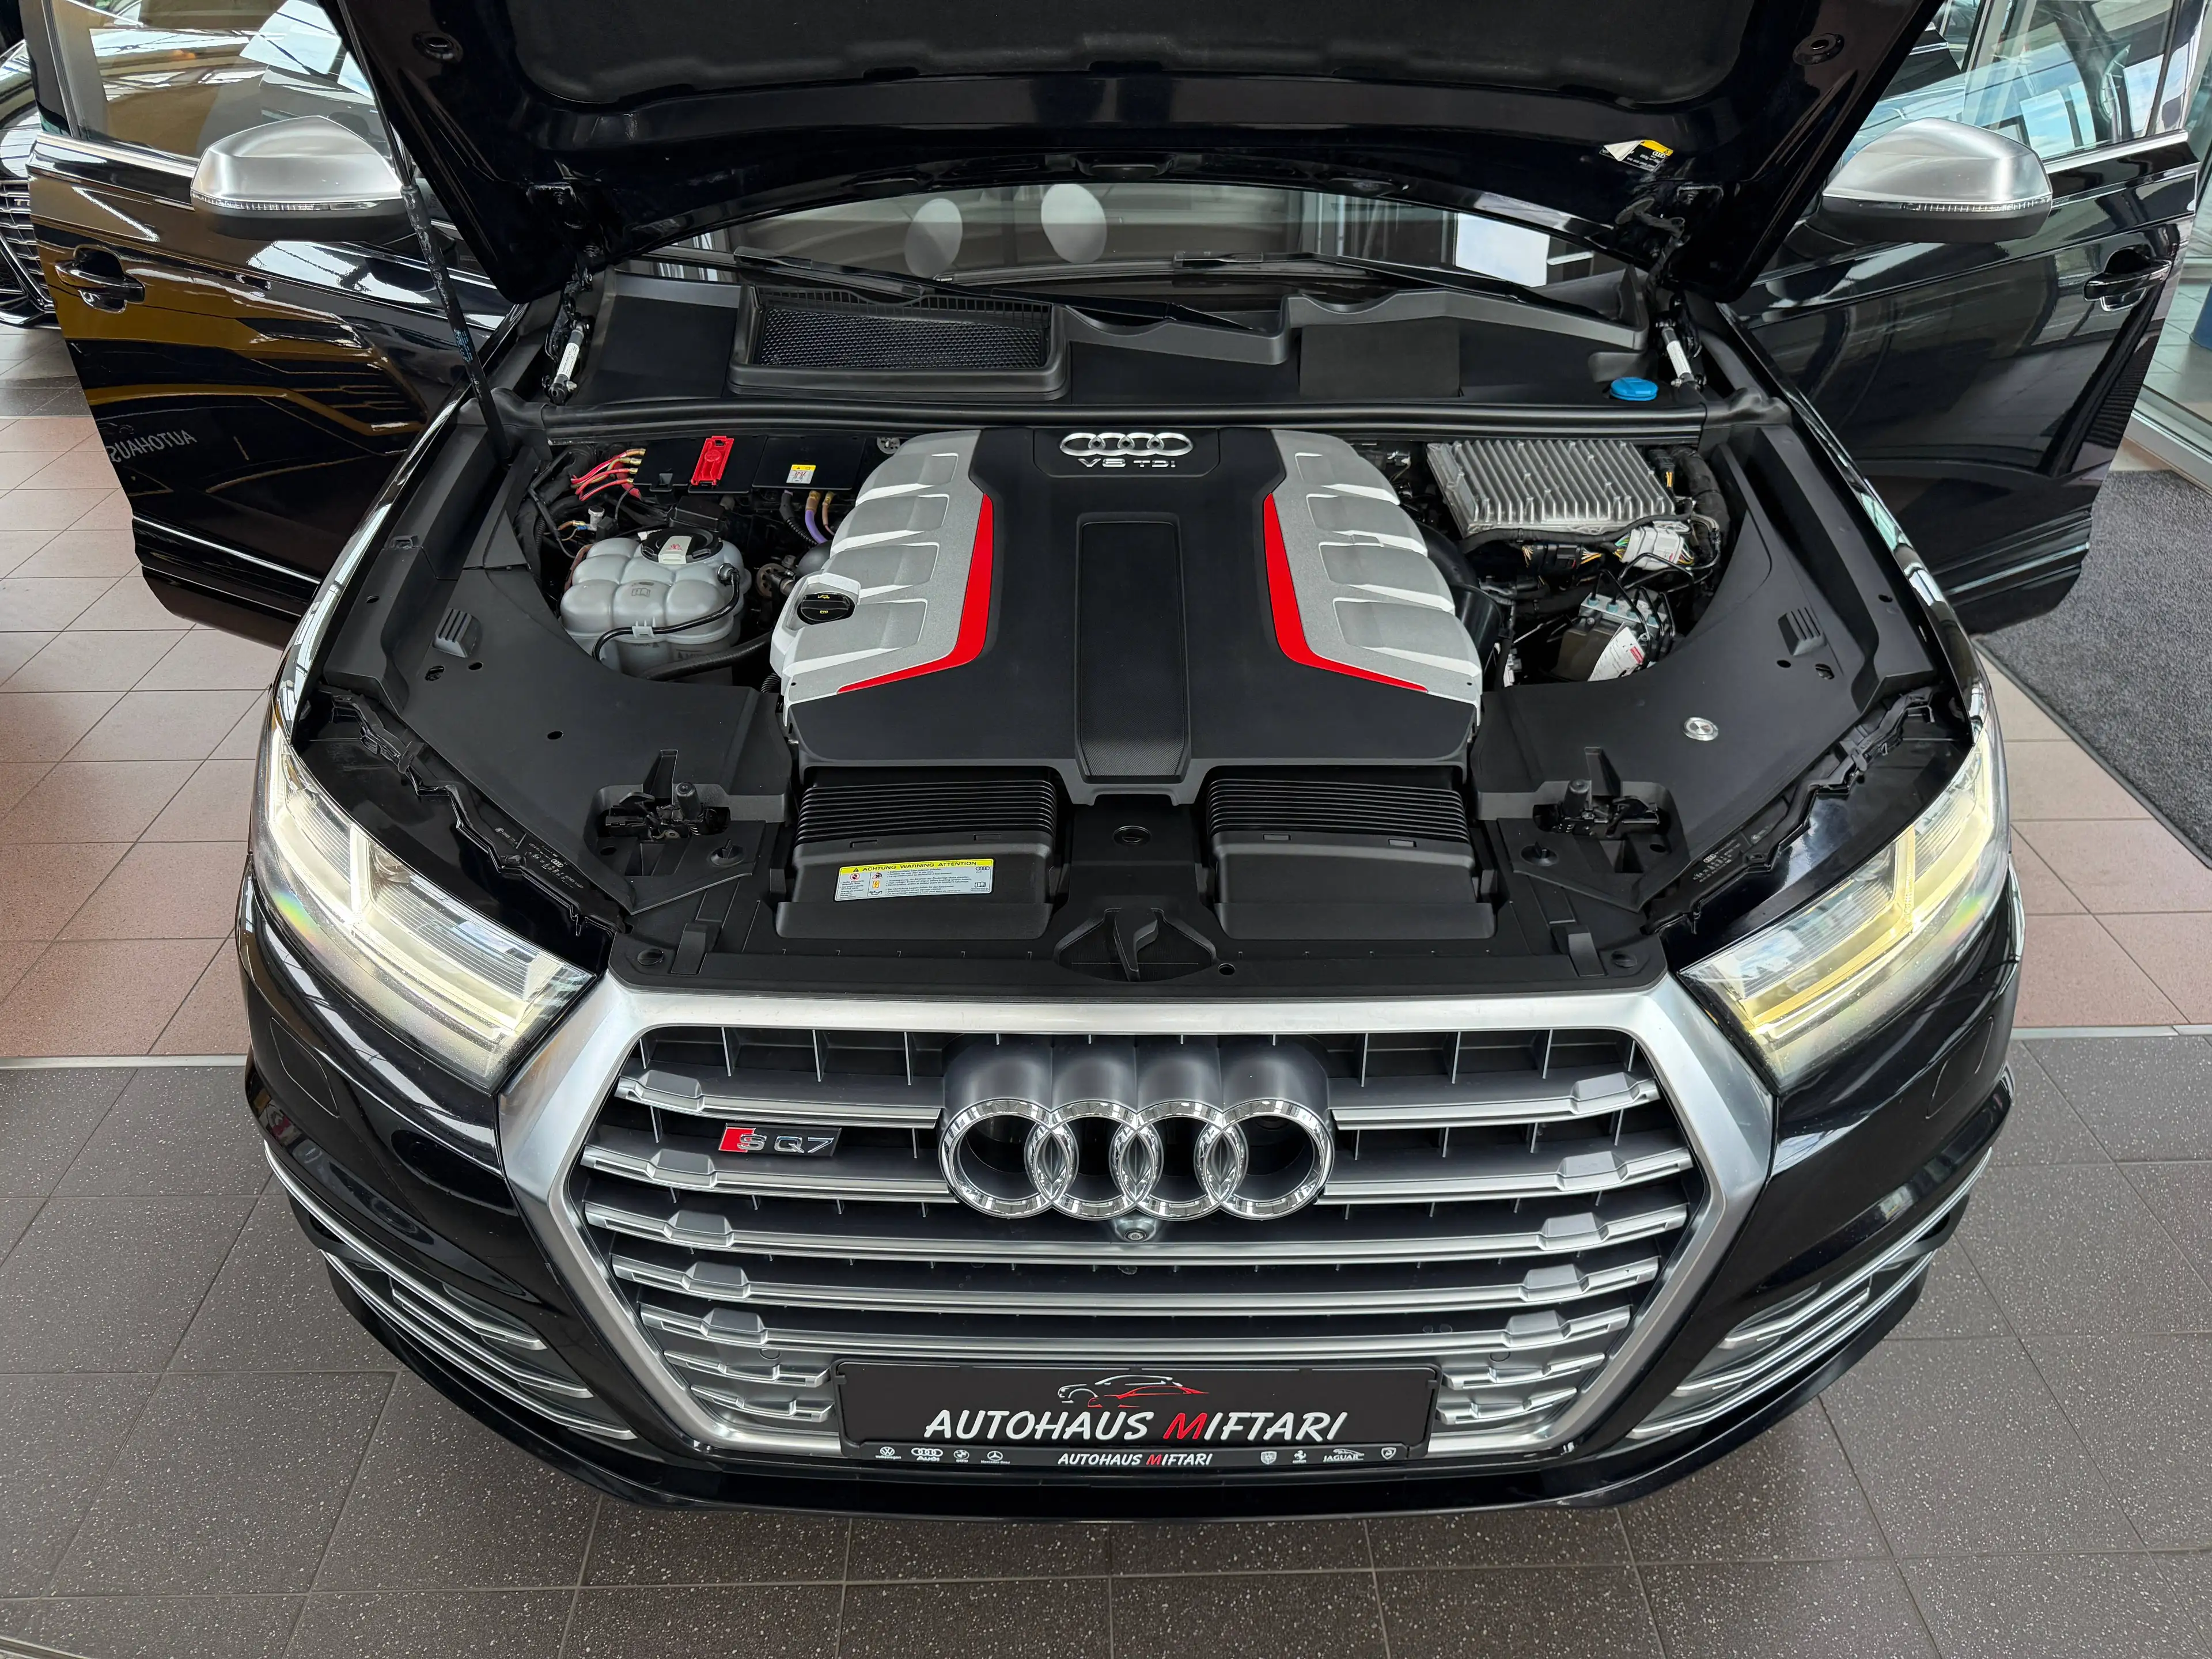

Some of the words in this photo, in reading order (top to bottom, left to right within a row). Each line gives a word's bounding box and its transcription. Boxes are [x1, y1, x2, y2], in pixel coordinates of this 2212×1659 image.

[1078, 458, 1126, 468] V8
[923, 1409, 1154, 1440] AUTOHAUS
[1163, 1411, 1349, 1442] MIFTARI
[1058, 1453, 1143, 1466] AUTOHAUS
[1146, 1453, 1213, 1466] MIFTARI
[1323, 1454, 1359, 1463] JAGUAR
